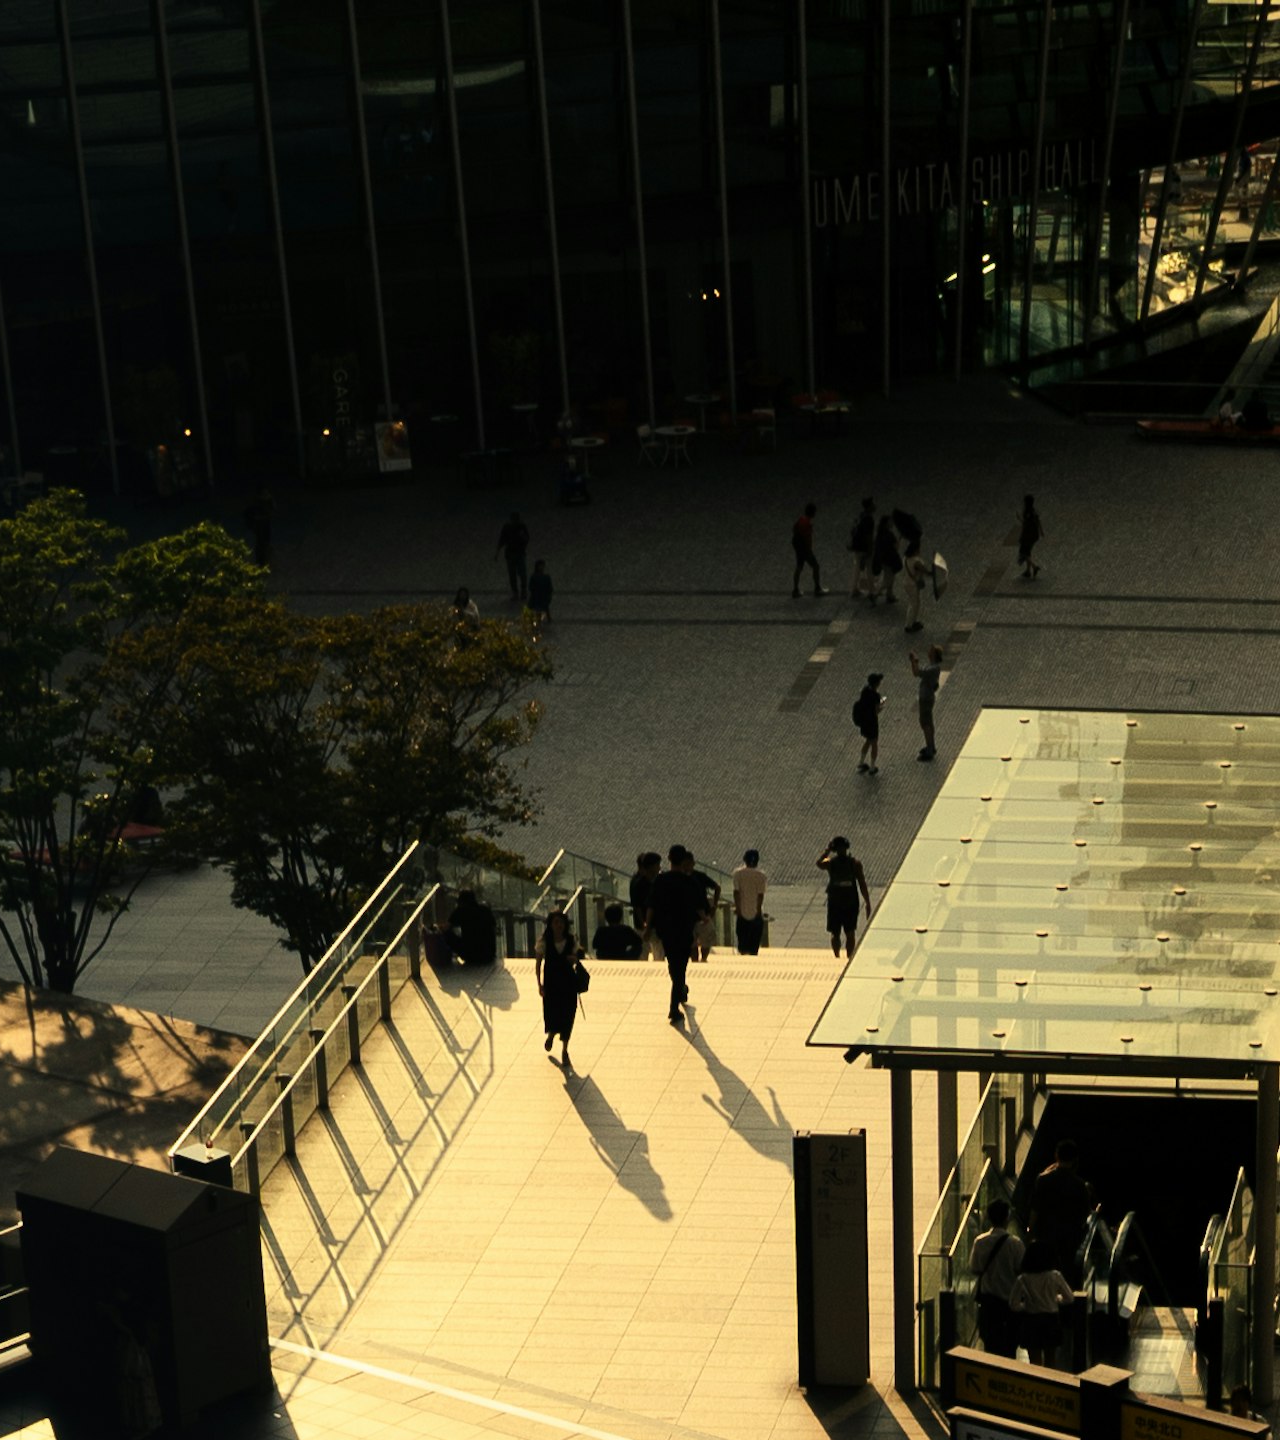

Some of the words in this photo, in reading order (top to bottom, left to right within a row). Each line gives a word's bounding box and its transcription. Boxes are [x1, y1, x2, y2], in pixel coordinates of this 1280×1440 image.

[971, 147, 1030, 205] SHIP
[1044, 138, 1100, 192] HALL
[829, 1144, 851, 1162] 2F
[1135, 1415, 1182, 1439] 中央北口
